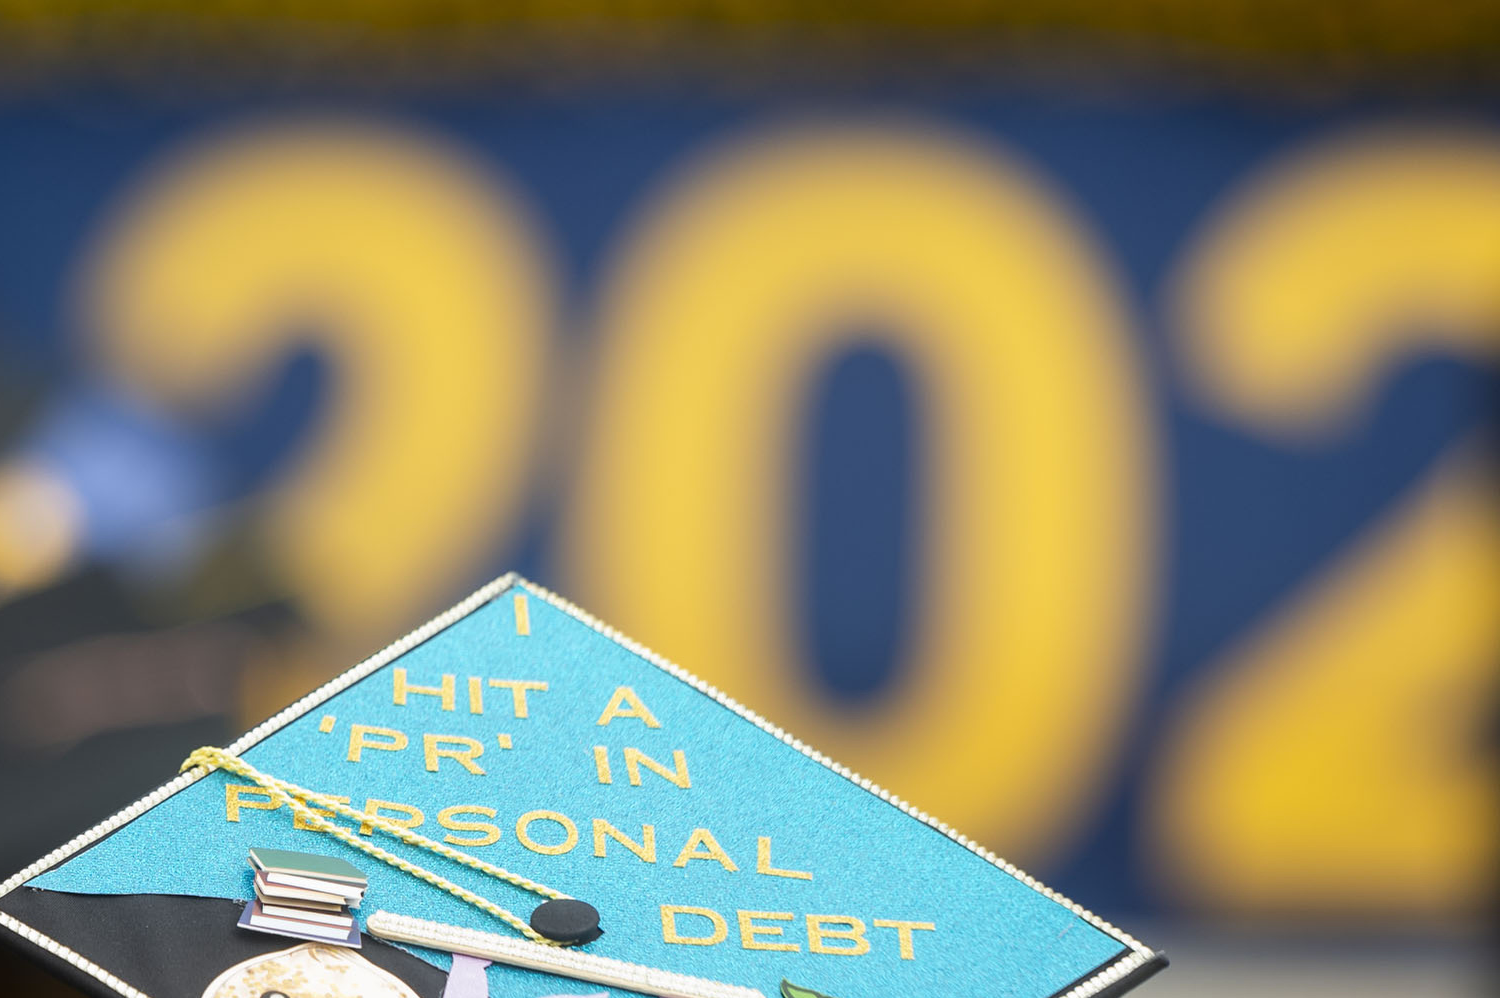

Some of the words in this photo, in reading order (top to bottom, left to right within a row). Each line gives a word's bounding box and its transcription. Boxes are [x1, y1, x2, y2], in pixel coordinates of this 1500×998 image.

[513, 594, 531, 637] I
[392, 667, 549, 719] HIT
[596, 686, 662, 729] A
[318, 714, 514, 776] 'PR'
[593, 745, 692, 790] IN
[225, 783, 814, 882] PERSONAL
[658, 903, 937, 961] DEBT
